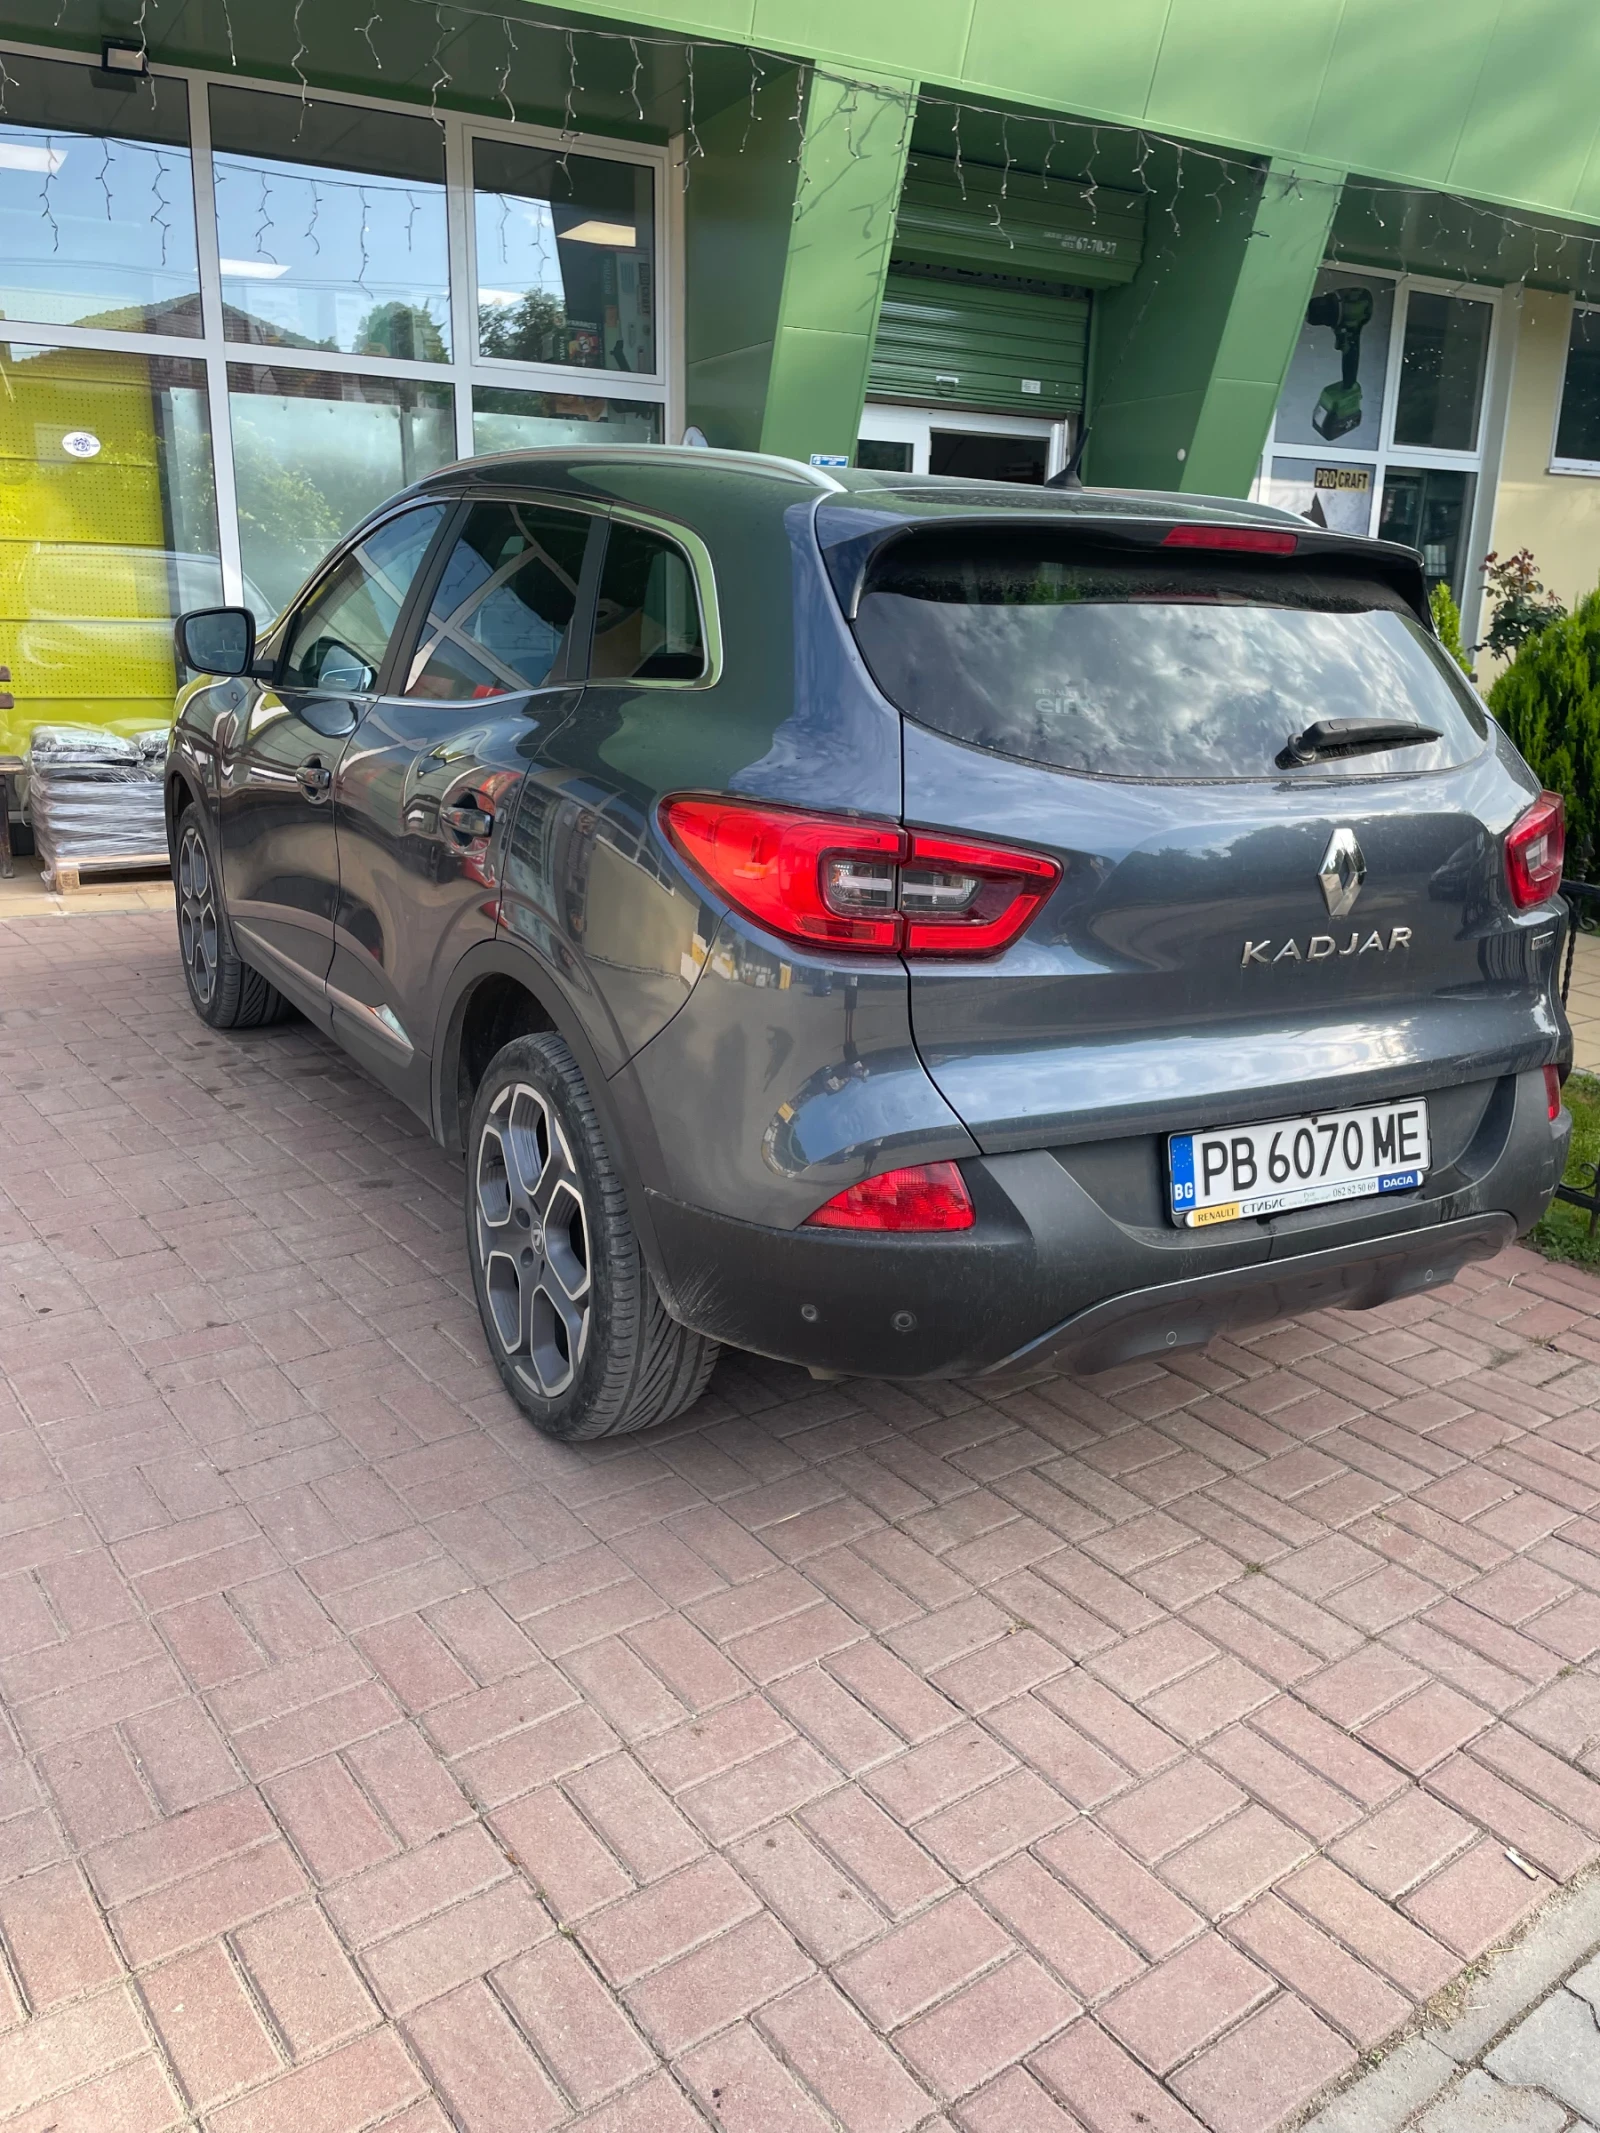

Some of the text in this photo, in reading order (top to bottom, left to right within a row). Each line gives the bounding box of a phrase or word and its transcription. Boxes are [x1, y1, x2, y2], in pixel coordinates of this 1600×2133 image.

[1076, 237, 1117, 254] 67-70-27
[1315, 469, 1368, 489] PRO CRAFT
[1241, 926, 1412, 965] KADJAR
[1202, 1110, 1422, 1197] PB 6070 ME
[1332, 1187, 1346, 1198] 082
[1347, 1185, 1357, 1195] 82
[1357, 1183, 1366, 1193] 50
[1382, 1175, 1414, 1189] DACIA
[1174, 1183, 1194, 1200] BG
[1242, 1197, 1286, 1214] СТИБИС
[1197, 1207, 1235, 1223] RENAULT
